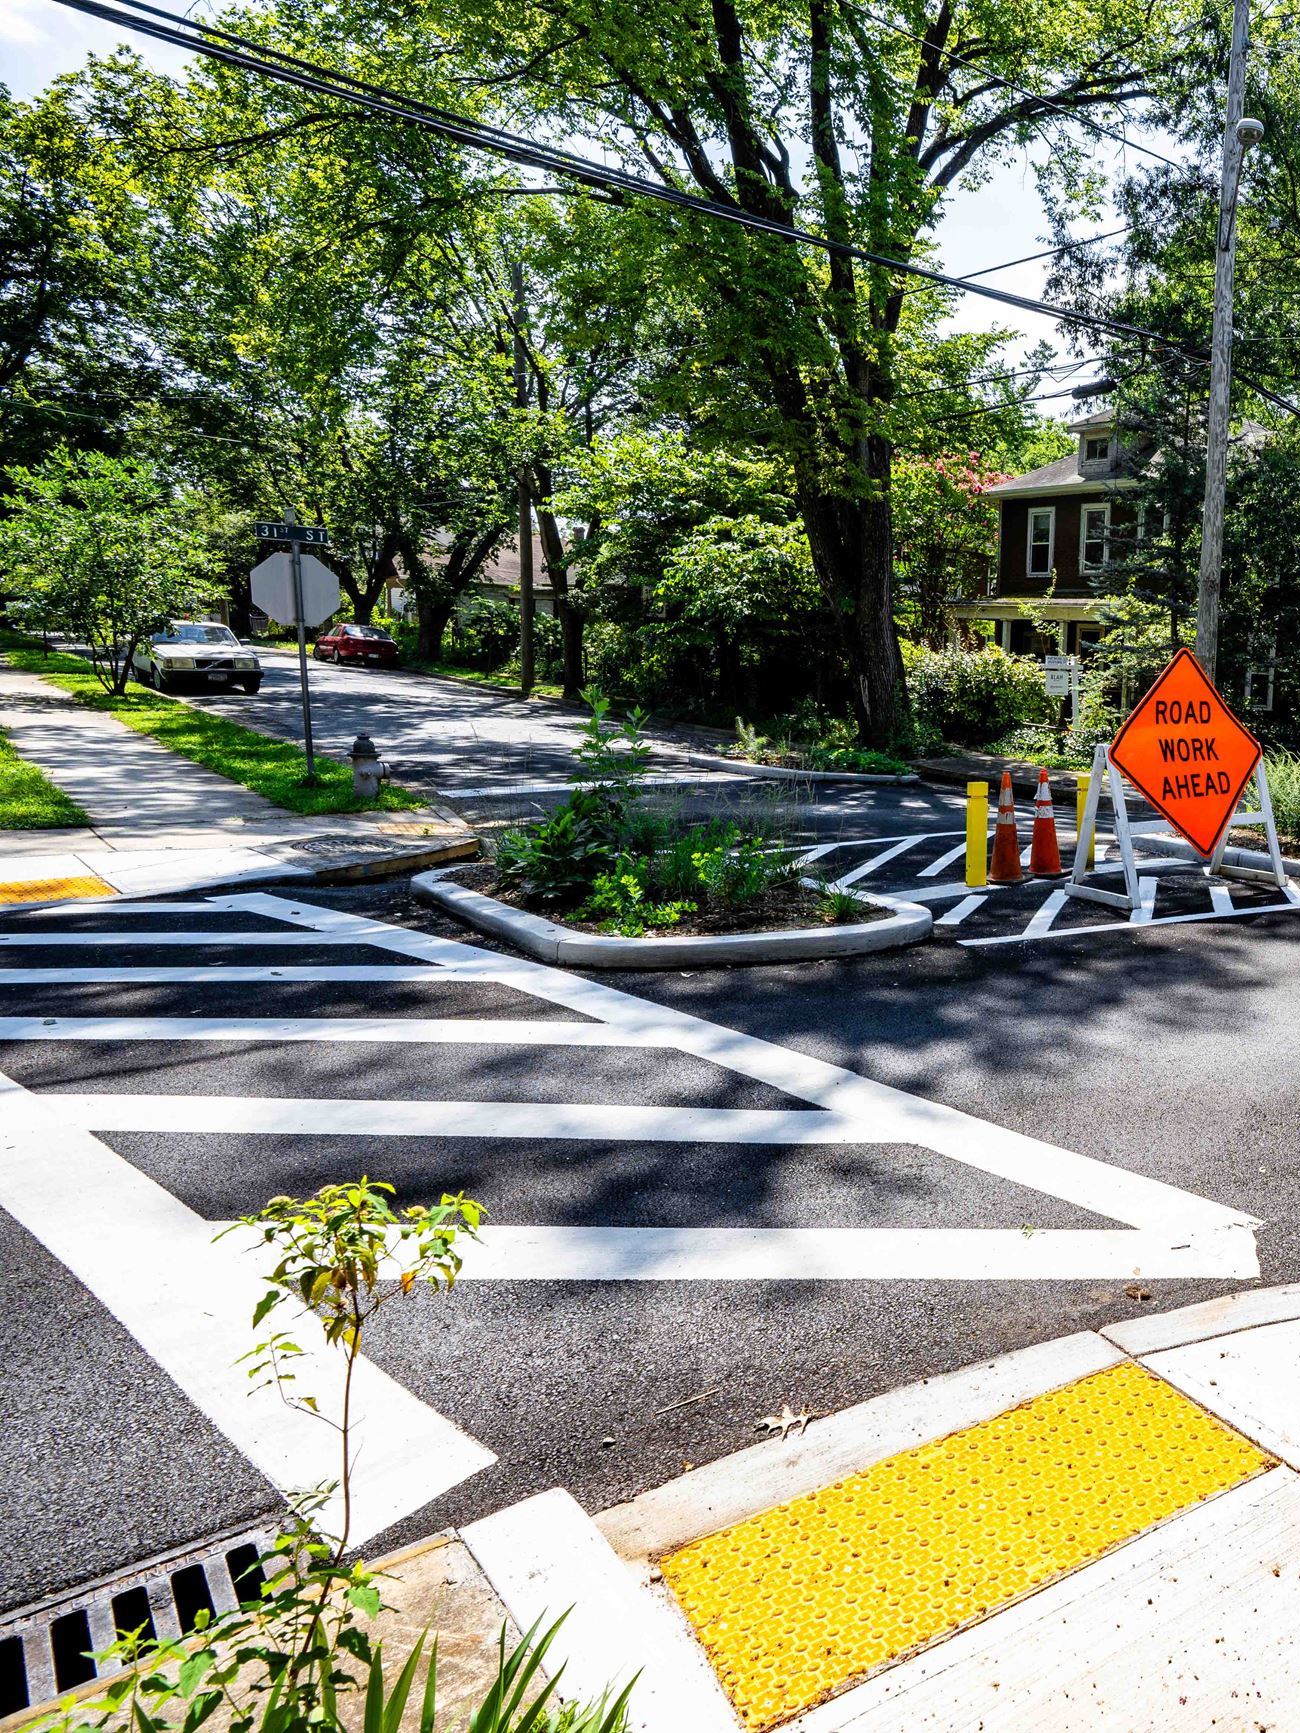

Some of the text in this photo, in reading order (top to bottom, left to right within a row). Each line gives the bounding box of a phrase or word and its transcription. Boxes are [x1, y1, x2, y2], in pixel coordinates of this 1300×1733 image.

[305, 530, 325, 542] ST
[1155, 700, 1211, 725] ROAD
[1158, 737, 1220, 763] WORK
[1161, 771, 1231, 801] AHEAD
